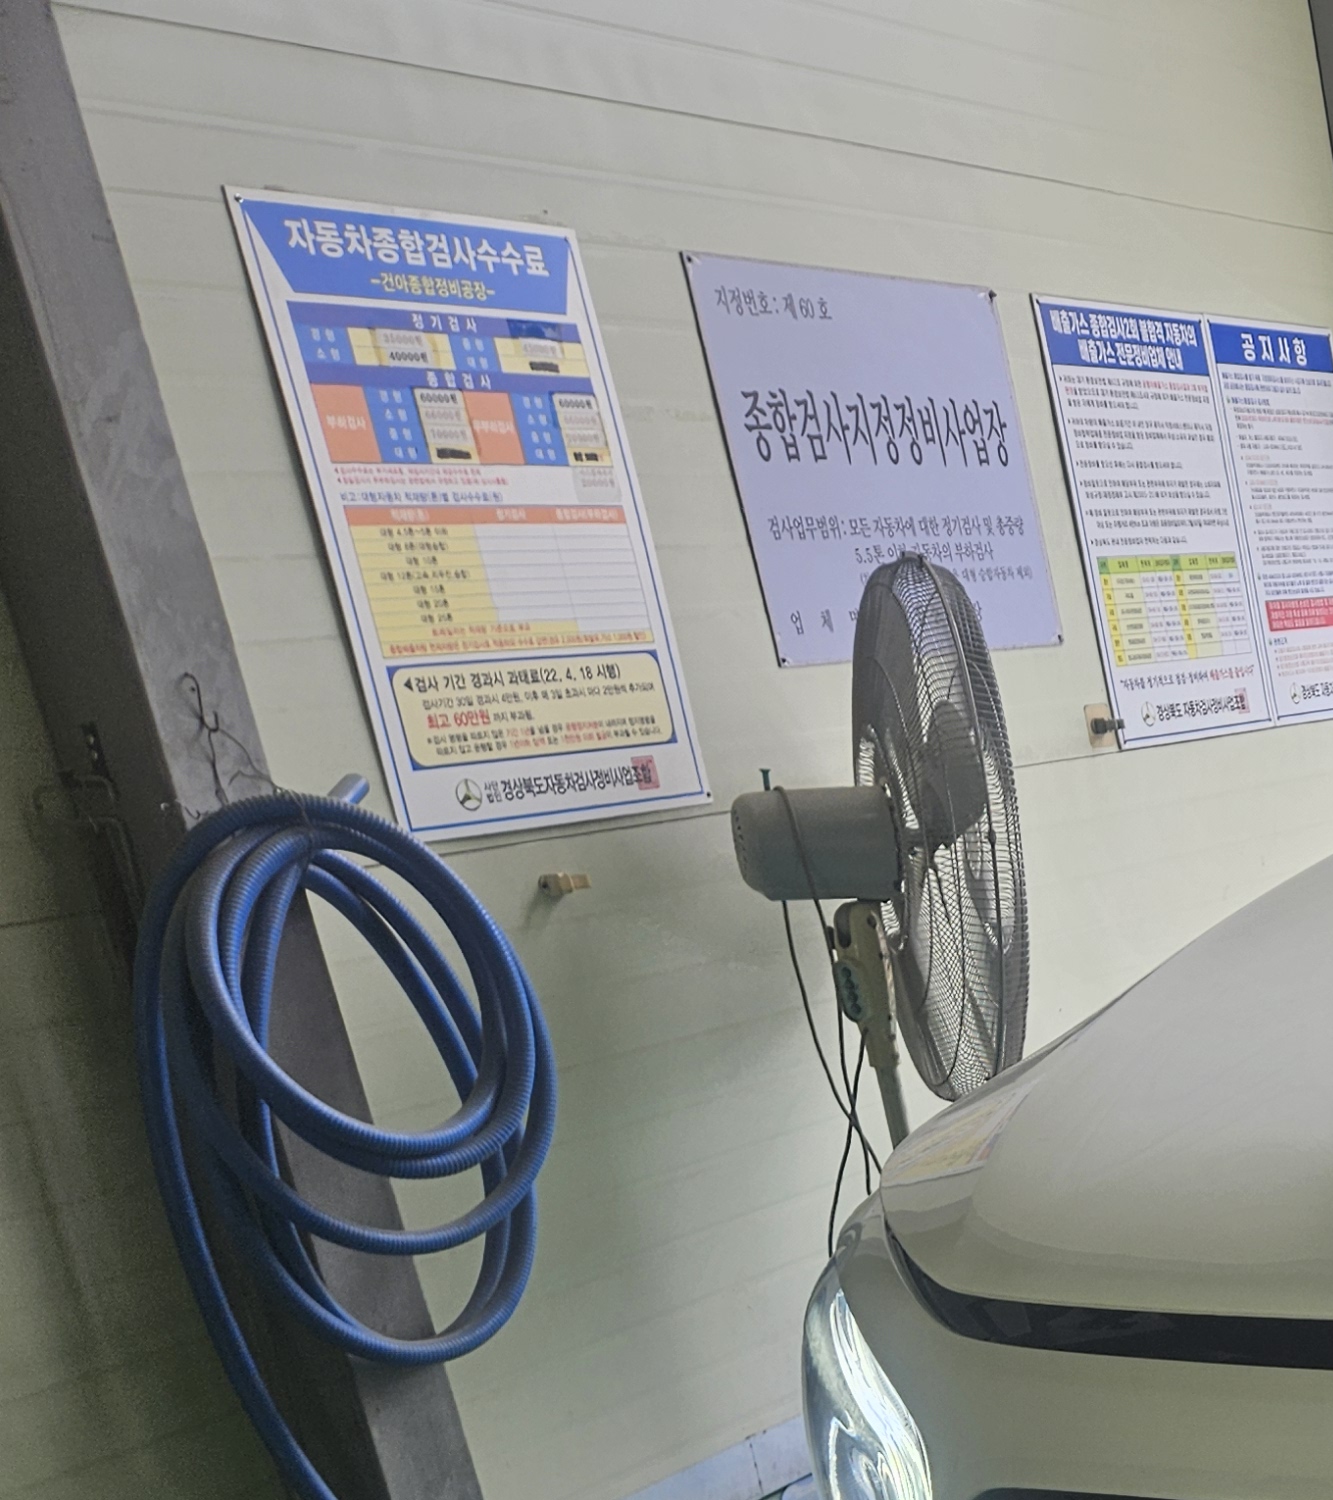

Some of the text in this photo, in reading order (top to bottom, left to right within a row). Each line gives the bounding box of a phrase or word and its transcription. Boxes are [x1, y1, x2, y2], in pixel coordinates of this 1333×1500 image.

[284, 218, 550, 277] 자동차종합검사수수료
[715, 286, 833, 321] 지정번호: 제 60 호
[1050, 309, 1090, 336] 배출가스
[1089, 313, 1140, 341] 종합검사2회
[1164, 321, 1197, 346] 자동차의
[1078, 338, 1116, 365] 배출가스
[1166, 346, 1183, 370] 안내
[1241, 332, 1308, 366] 공지사항
[741, 388, 1009, 467] 종합검사지정정비사업장
[768, 513, 848, 541] 검사업무범위:
[850, 518, 871, 538] 모든
[873, 516, 917, 538] 자동차에
[918, 515, 940, 537] 대한
[941, 515, 981, 537] 정기검사
[982, 515, 995, 537] 및
[955, 541, 994, 562] 부하검사
[415, 675, 439, 693] 검사
[443, 673, 467, 691] 기간
[470, 671, 505, 689] 경과시
[580, 664, 593, 680] 18
[426, 712, 451, 729] 최고
[453, 709, 491, 727] 60만원
